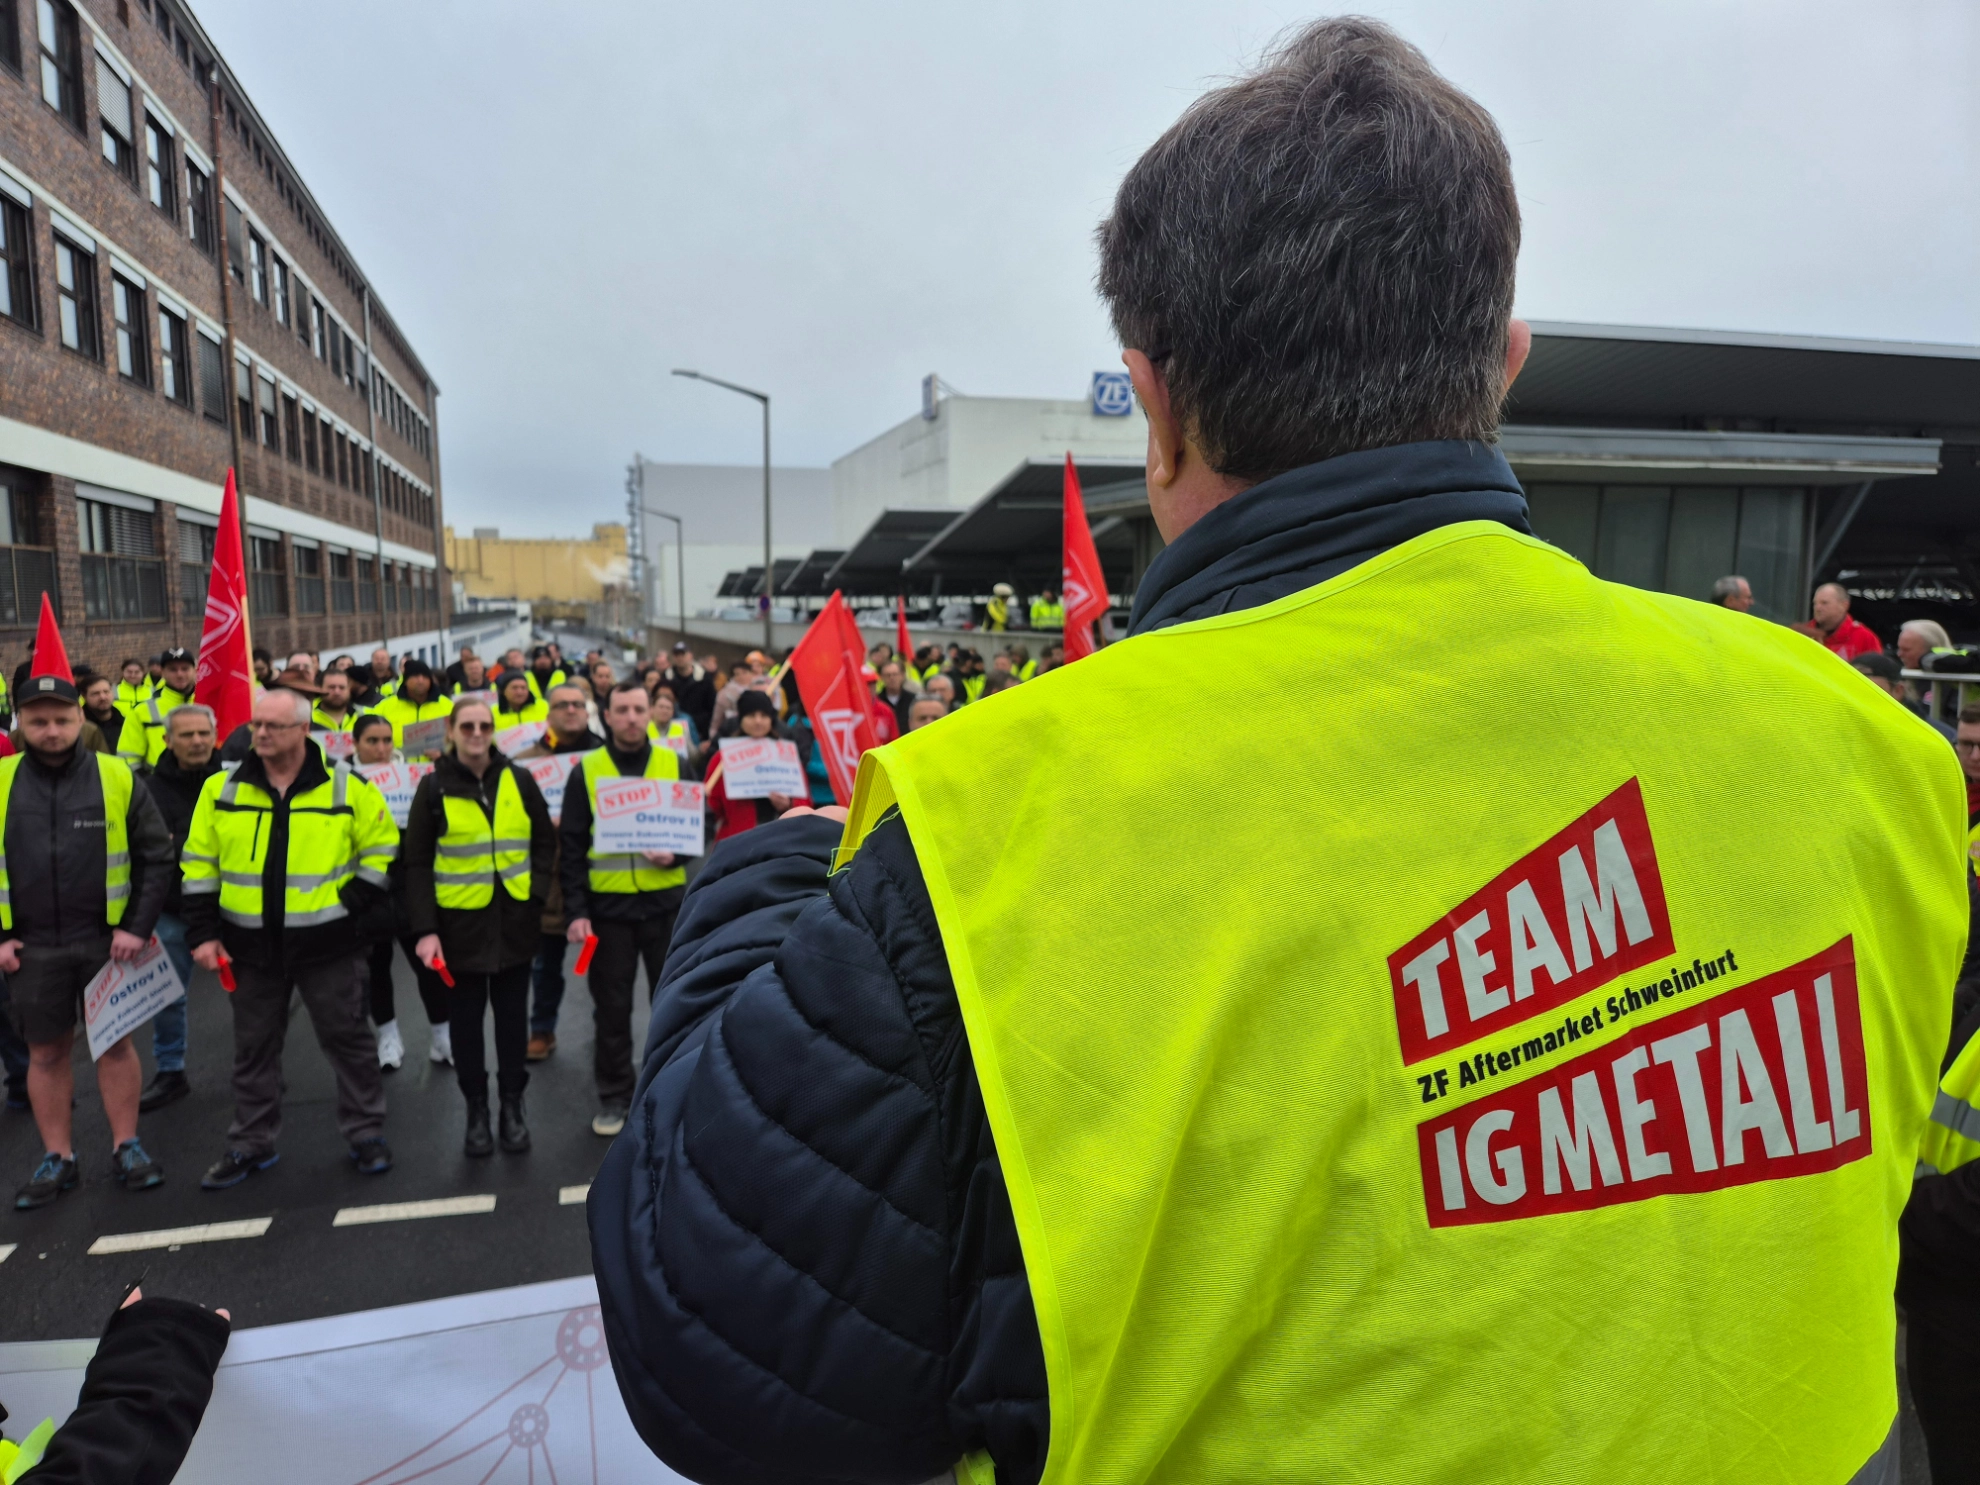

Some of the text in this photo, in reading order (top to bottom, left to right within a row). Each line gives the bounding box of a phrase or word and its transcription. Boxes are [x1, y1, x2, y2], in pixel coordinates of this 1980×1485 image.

[1099, 381, 1128, 406] ZF
[603, 787, 652, 808] STOP
[635, 811, 685, 825] Ostrov
[1401, 817, 1654, 1041] TEAM
[109, 971, 155, 1006] Ostrov
[1416, 949, 1739, 1104] ZF Aftermarket Schweinfurt
[1434, 971, 1861, 1212] IG METALL
